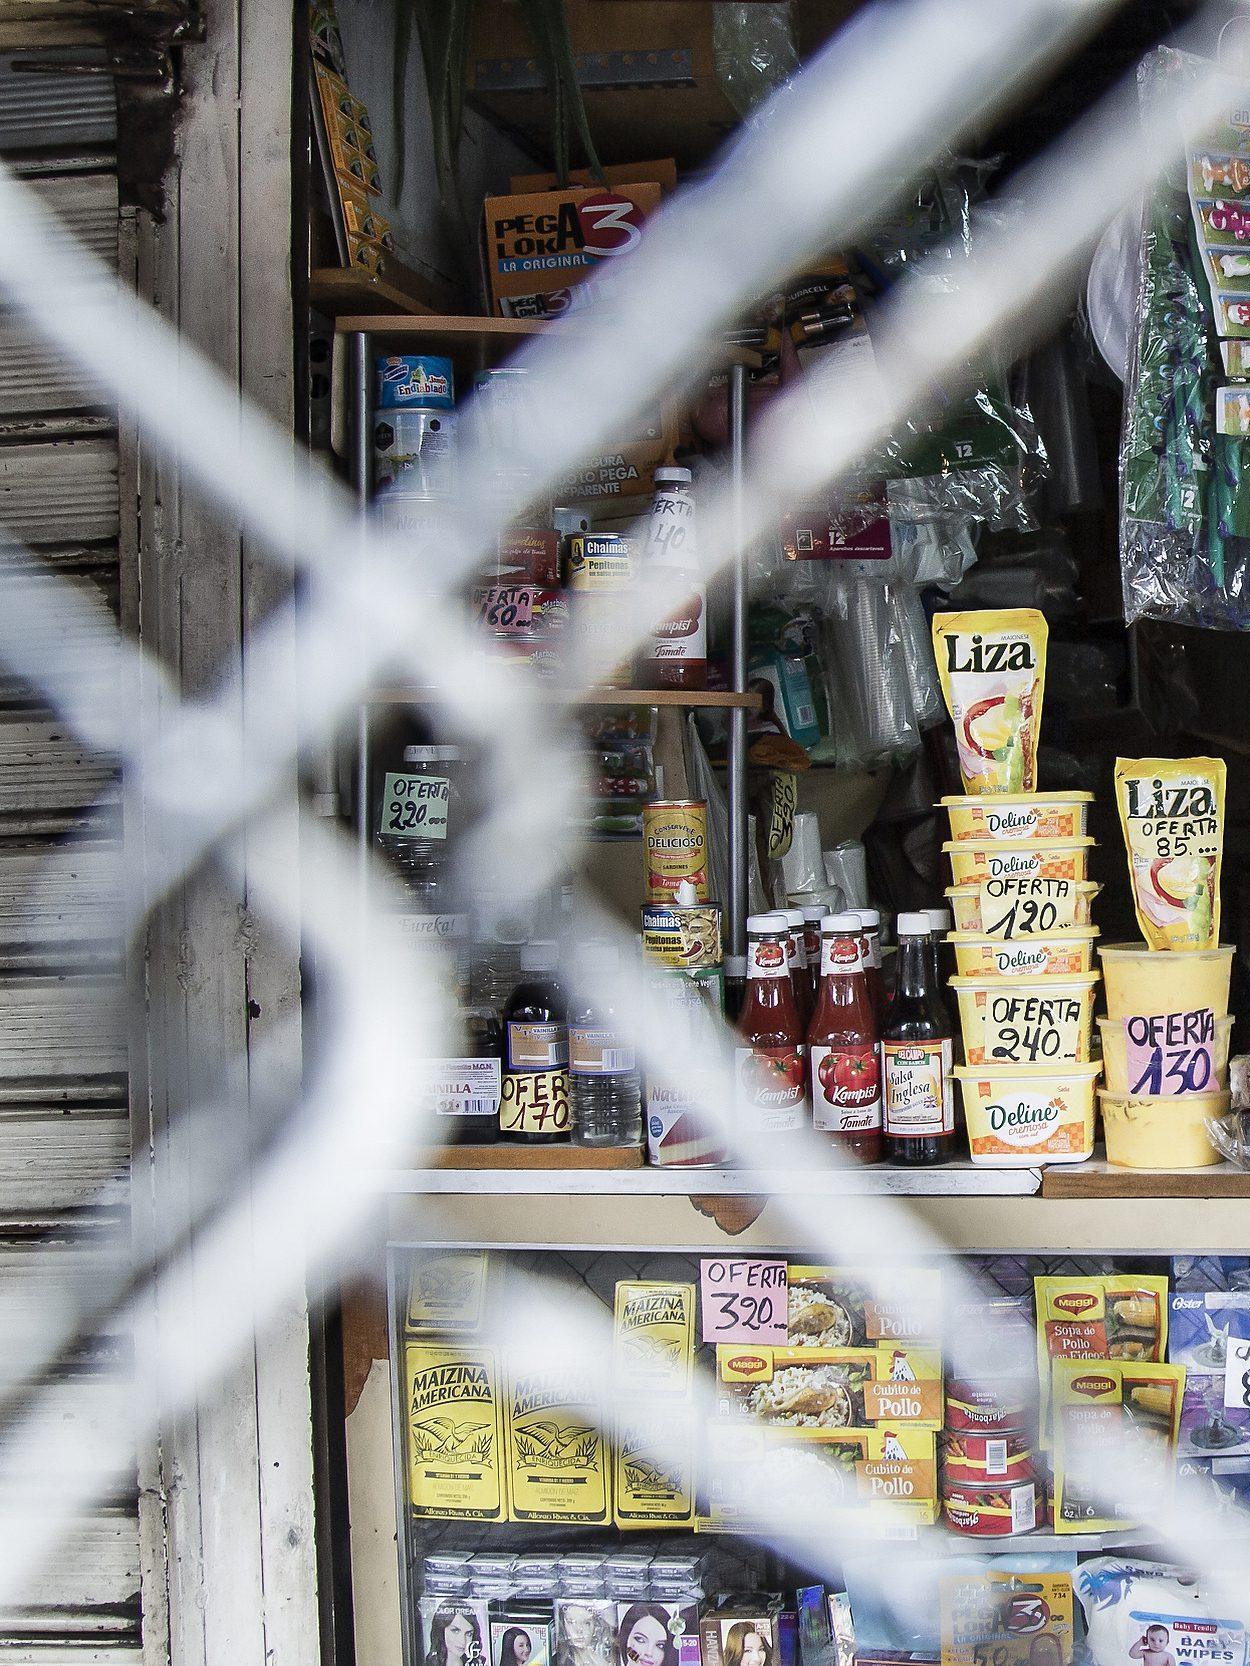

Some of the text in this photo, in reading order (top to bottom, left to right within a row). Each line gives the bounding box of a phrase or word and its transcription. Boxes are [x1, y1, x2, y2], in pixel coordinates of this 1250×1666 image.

[503, 255, 588, 272] LA ORIGINAL
[398, 382, 447, 395] Endiablado
[828, 529, 848, 545] 12
[587, 542, 629, 554] Chaimas
[654, 619, 692, 635] ampist
[655, 645, 687, 657] Tomate
[944, 634, 1036, 673] Liza
[393, 778, 449, 801] OFERTA
[1124, 779, 1217, 819] Liza
[986, 811, 1038, 832] Deline
[1142, 817, 1218, 837] OFERTA
[648, 835, 703, 848] DELICIOSO
[989, 856, 1041, 876] Deline
[986, 879, 1069, 898] OFERTA
[644, 914, 681, 928] Chaimas
[645, 934, 682, 946] Pepitonas
[995, 949, 1048, 971] Deline
[992, 997, 1081, 1026] OFERTA
[1127, 1007, 1215, 1048] OFERTA
[890, 1069, 914, 1086] Salsa
[1130, 1047, 1212, 1095] 130
[425, 1083, 472, 1094] AINILLA
[501, 1073, 569, 1106] OFER
[755, 1084, 801, 1105] Kampist
[832, 1084, 878, 1104] Kampist
[891, 1082, 930, 1106] Inglesa
[505, 1101, 569, 1130] 170
[839, 1115, 874, 1130] Tomate
[985, 1101, 1059, 1131] Deline
[1008, 1121, 1048, 1136] cremosa
[707, 1262, 788, 1288] OFERTA
[622, 1294, 684, 1318] MAIZINA
[1058, 1298, 1093, 1309] Maggi
[1172, 1297, 1204, 1311] Oster
[621, 1310, 686, 1330] AMERICANA
[1054, 1325, 1096, 1337] Sopa de
[1063, 1338, 1091, 1350] Pollo
[732, 1359, 763, 1370] Maggi
[413, 1367, 490, 1396] MAIZINA
[1076, 1380, 1111, 1391] Maggi
[411, 1385, 492, 1413] AMERICANA
[873, 1385, 921, 1396] Cubito de
[878, 1398, 922, 1417] Pollo
[1069, 1409, 1112, 1421] Sopa de
[532, 1457, 581, 1468] ENRIQUECIDA
[865, 1464, 913, 1475] Cubito de
[871, 1478, 914, 1496] Pollo
[1174, 1622, 1191, 1631] Baby
[1176, 1647, 1234, 1661] WIPES
